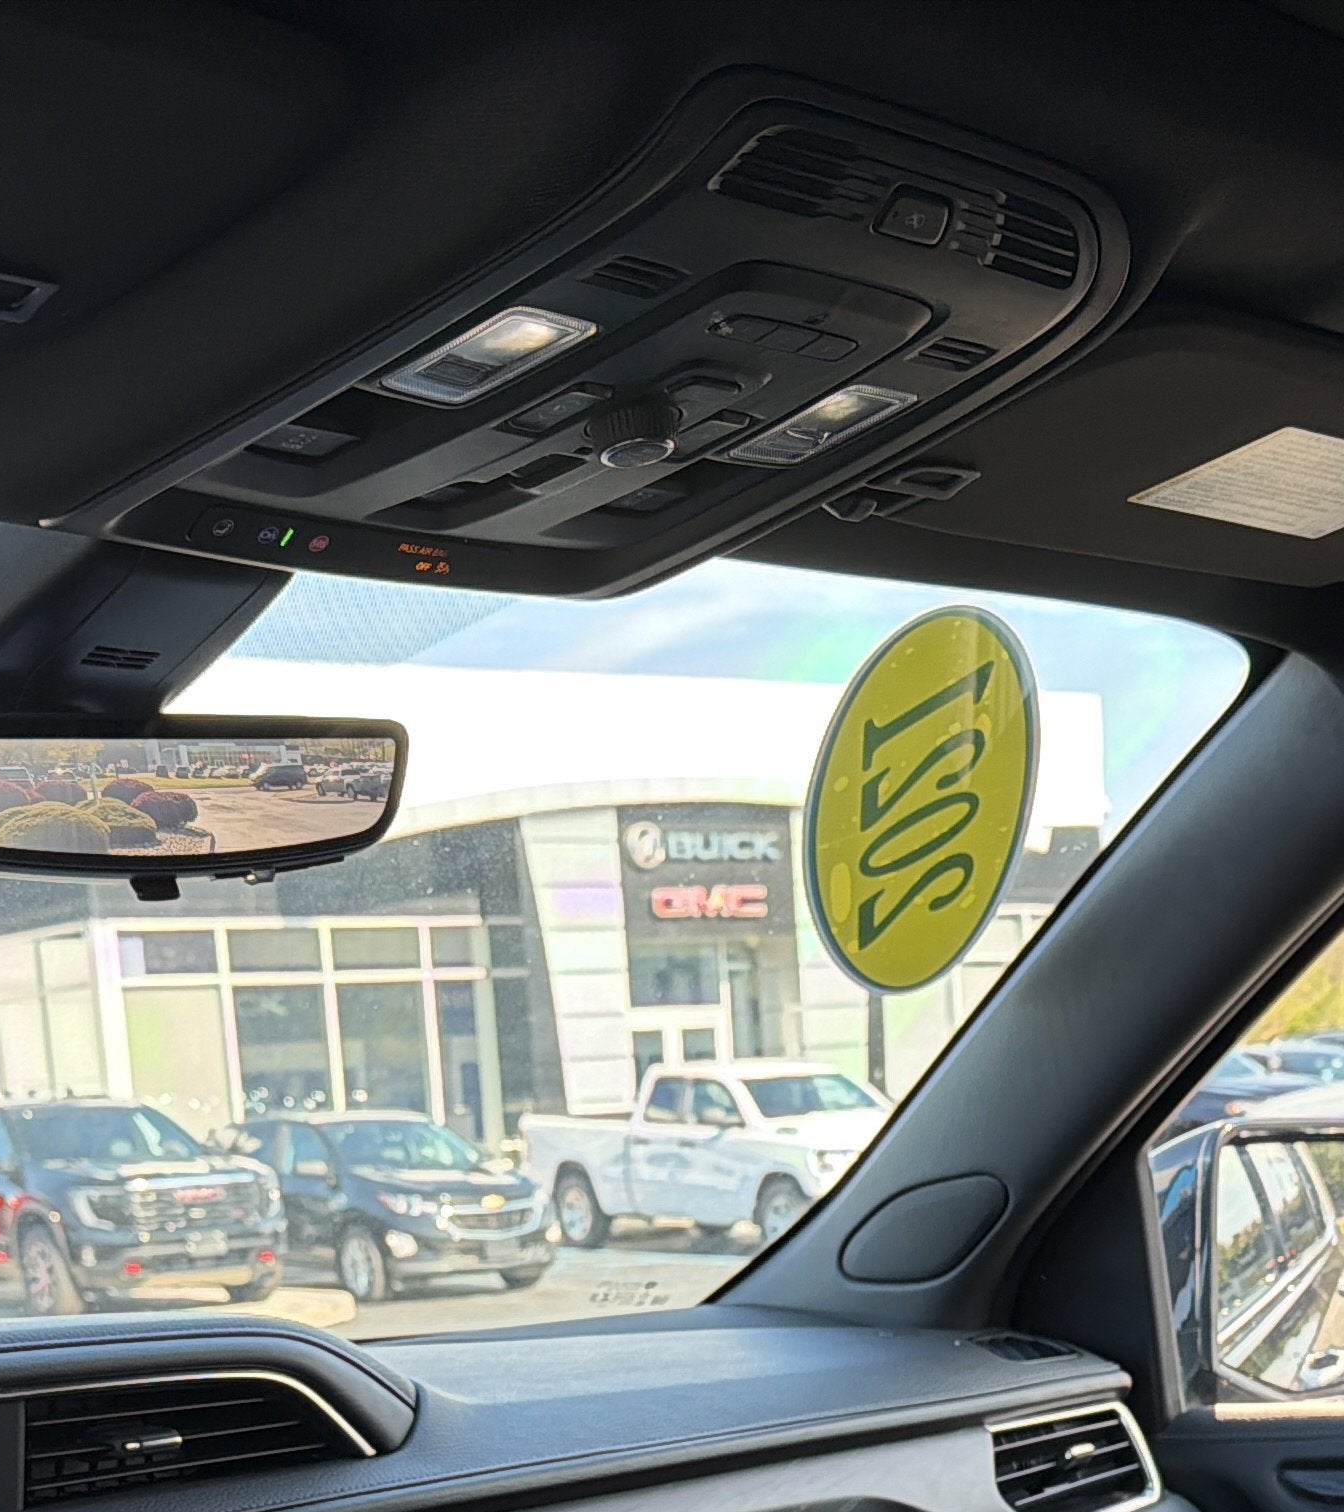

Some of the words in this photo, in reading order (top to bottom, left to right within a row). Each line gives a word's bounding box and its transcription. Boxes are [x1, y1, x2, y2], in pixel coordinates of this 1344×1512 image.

[415, 561, 433, 573] OFF
[666, 828, 783, 862] BUICK
[650, 884, 769, 919] GMC
